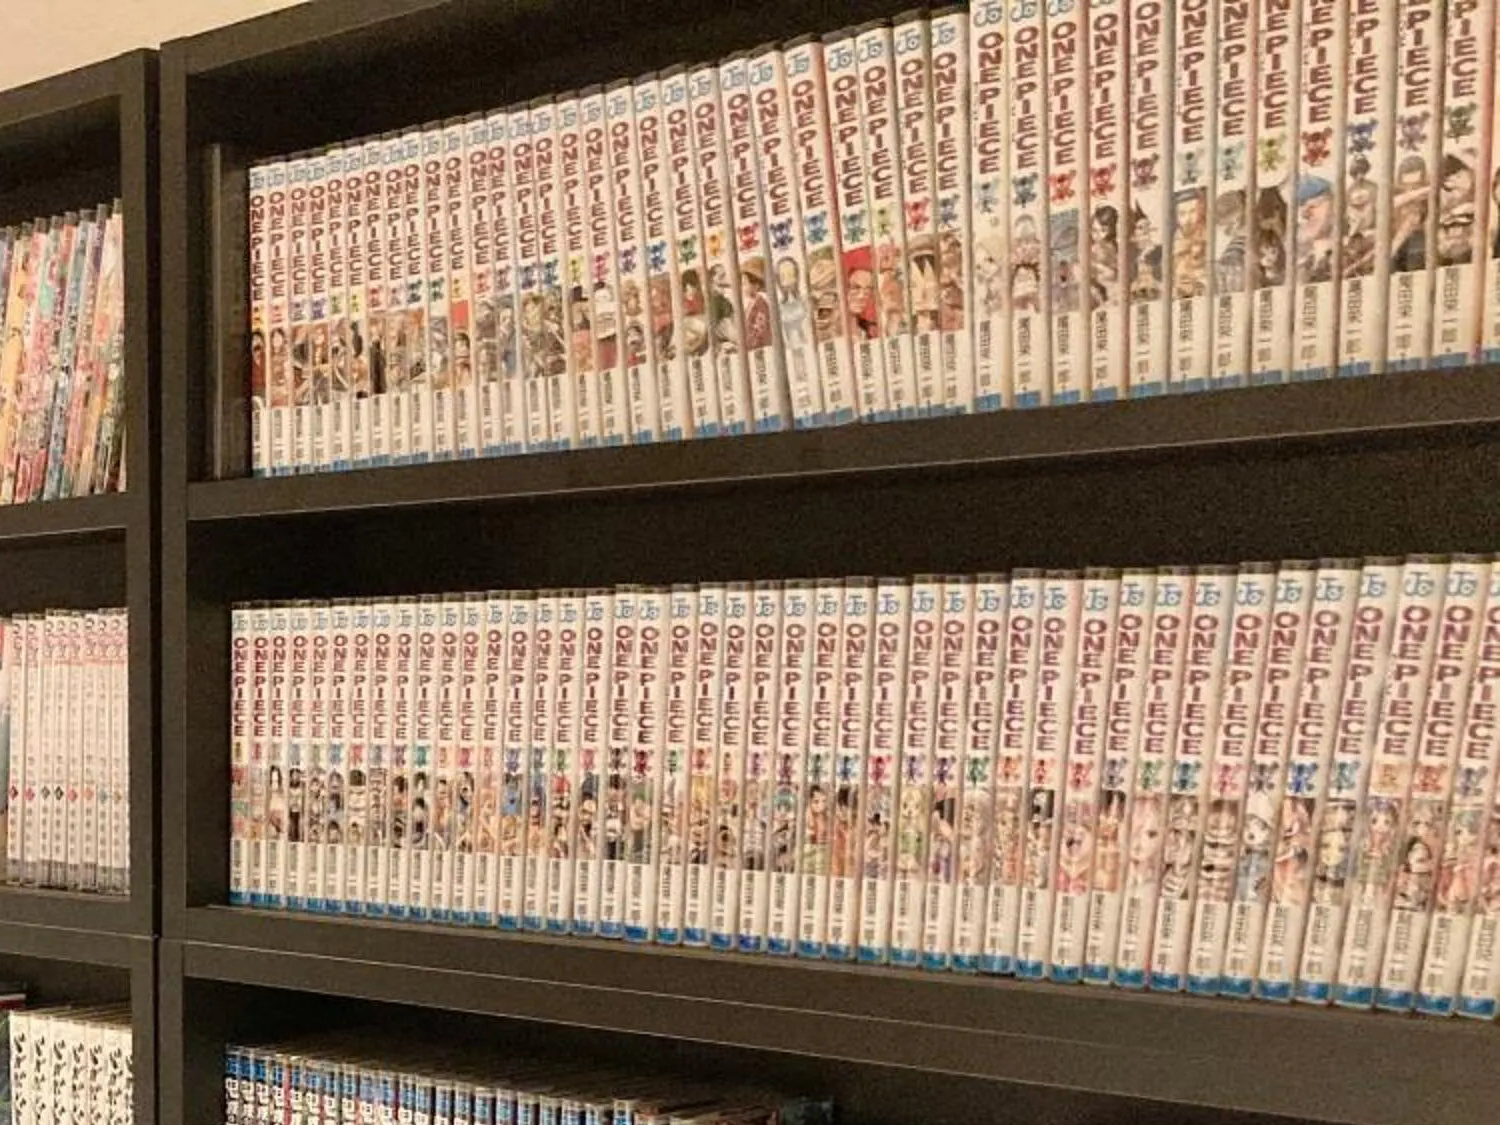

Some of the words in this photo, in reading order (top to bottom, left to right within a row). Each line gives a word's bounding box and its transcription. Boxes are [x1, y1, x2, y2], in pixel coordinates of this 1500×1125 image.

[978, 31, 1004, 84] ONE
[1014, 26, 1039, 78] ONE
[1051, 21, 1076, 74] ONE
[1094, 13, 1118, 66] ONE
[1136, 3, 1160, 56] ONE
[1224, 0, 1248, 40] NE
[1405, 10, 1430, 107] PIECE
[1452, 0, 1477, 98] PIECE
[792, 80, 814, 126] ONE
[833, 75, 857, 124] ONE
[864, 66, 887, 114] ONE
[901, 58, 924, 108] ONE
[934, 52, 957, 104] ONE
[1136, 60, 1158, 150] PIECE
[1183, 53, 1204, 143] PIECE
[1223, 45, 1245, 137] PIECE
[1264, 35, 1288, 129] PIECE
[1309, 29, 1333, 123] PIECE
[1355, 18, 1378, 114] PIECE
[904, 111, 928, 193] PIECE
[936, 106, 957, 190] PIECE
[978, 88, 999, 174] PIECE
[1016, 82, 1037, 169] PIECE
[1054, 77, 1075, 165] PIECE
[1095, 69, 1116, 159] PIECE
[798, 130, 822, 208] PIECE
[839, 126, 861, 207] PIECE
[868, 118, 893, 200] PIECE
[1010, 615, 1033, 664] ONE
[1082, 619, 1107, 668] ONE
[1118, 614, 1142, 664] ONE
[1153, 614, 1179, 665] ONE
[1191, 614, 1218, 665] ONE
[1233, 613, 1262, 665] ONE
[1271, 612, 1299, 664] ONE
[1310, 610, 1340, 663] ONE
[1354, 606, 1383, 660] ONE
[1399, 605, 1430, 660] ONE
[1441, 605, 1473, 660] ONE
[1004, 668, 1027, 749] PIECE
[1074, 673, 1100, 754] PIECE
[1109, 668, 1134, 750] PIECE
[1145, 670, 1171, 752] PIECE
[1182, 670, 1209, 755] PIECE
[1222, 670, 1252, 756] PIECE
[1259, 669, 1289, 755] PIECE
[1298, 668, 1329, 755] PIECE
[1339, 665, 1372, 754] PIECE
[1384, 665, 1418, 755] PIECE
[1425, 665, 1460, 756] PIECE
